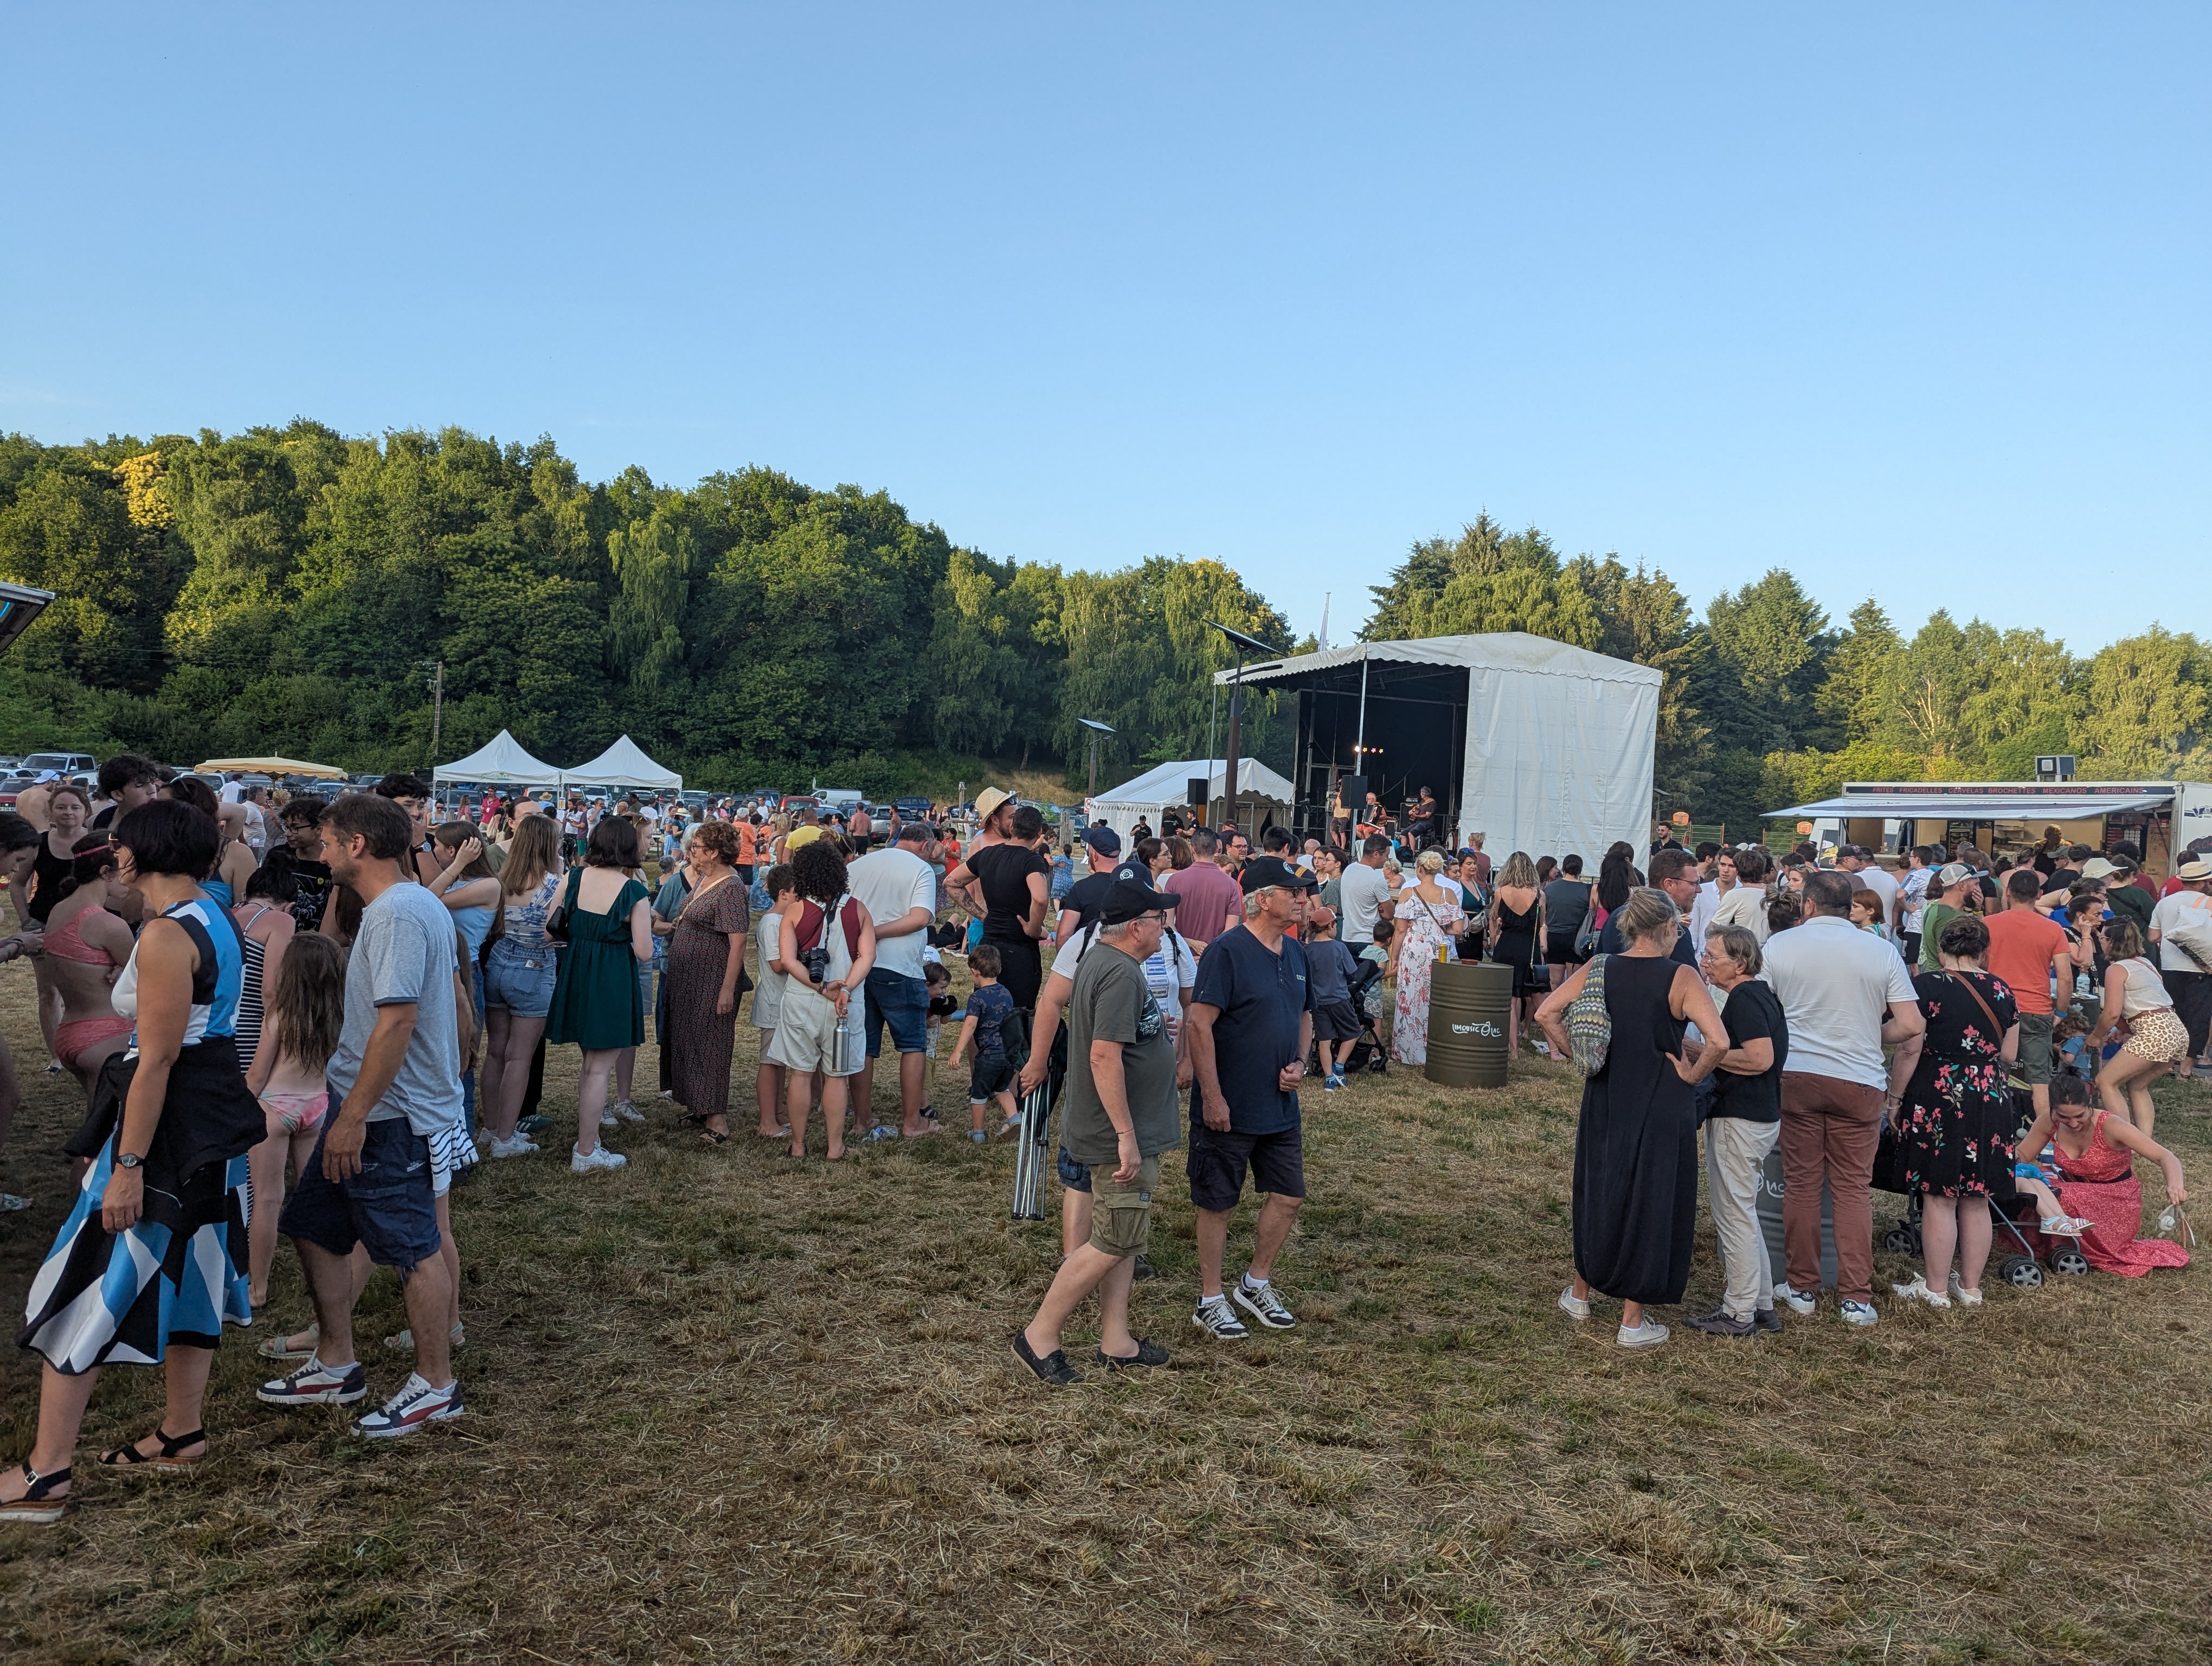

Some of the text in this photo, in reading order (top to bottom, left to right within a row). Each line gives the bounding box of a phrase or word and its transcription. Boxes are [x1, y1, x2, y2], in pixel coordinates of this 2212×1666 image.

[1452, 1023, 1480, 1034] LIMOUSIC
[1491, 1028, 1502, 1037] LAC
[1766, 1180, 1785, 1198] LAC
